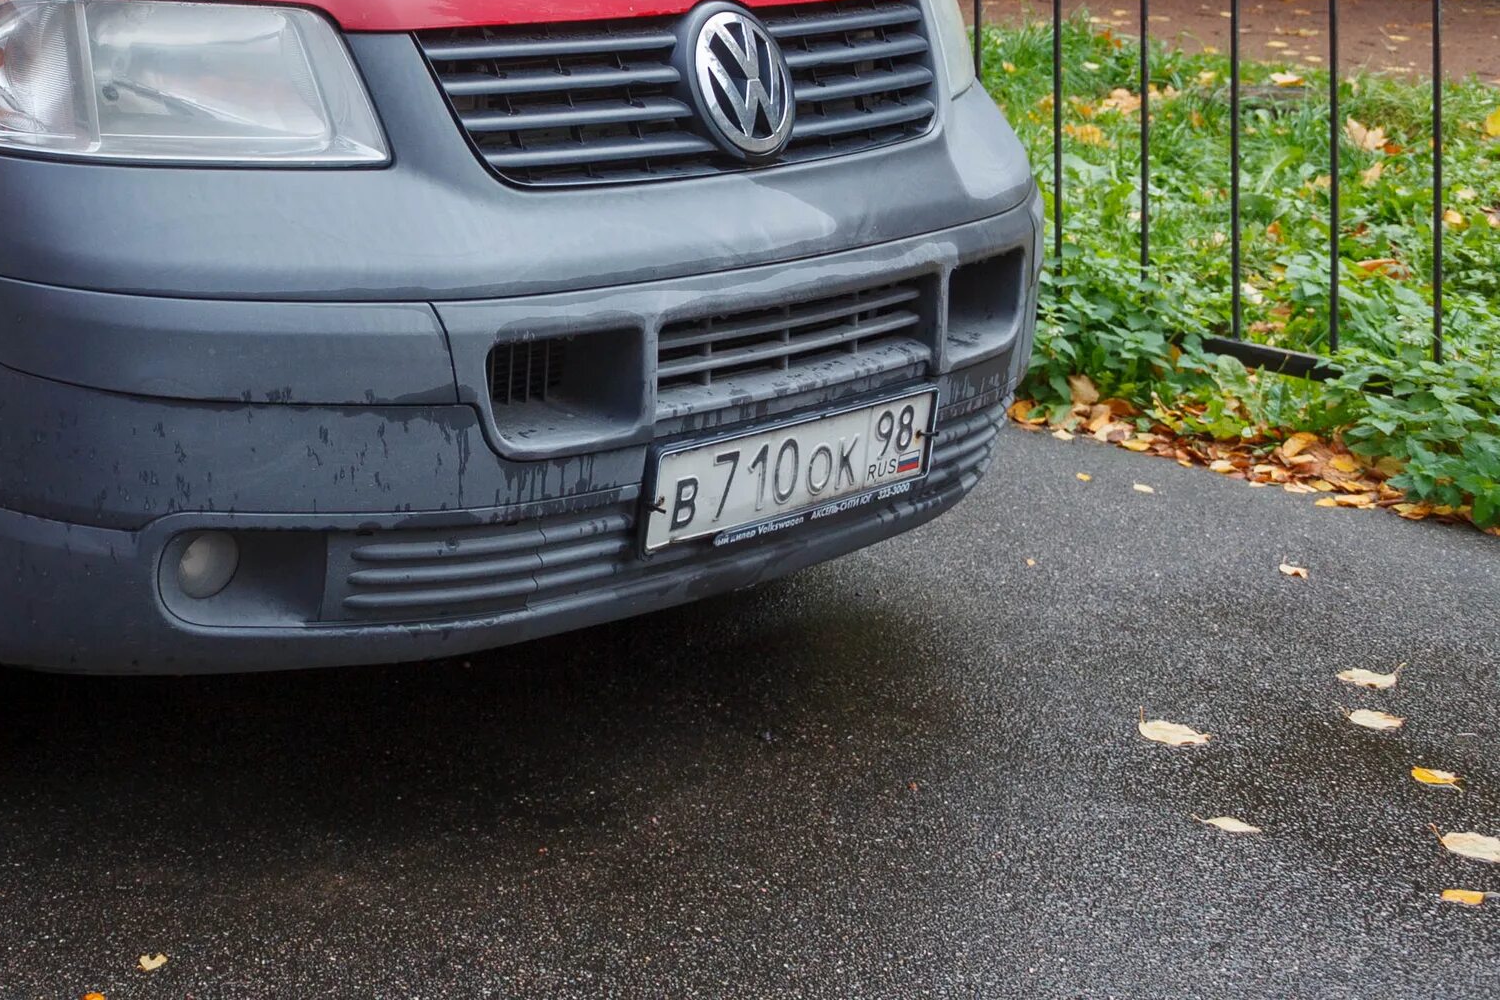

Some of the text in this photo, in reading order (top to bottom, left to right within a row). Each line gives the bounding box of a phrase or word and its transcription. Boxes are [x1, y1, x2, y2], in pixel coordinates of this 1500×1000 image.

[876, 405, 915, 458] 98
[867, 458, 897, 481] RUS
[758, 516, 805, 536] Volkswagen
